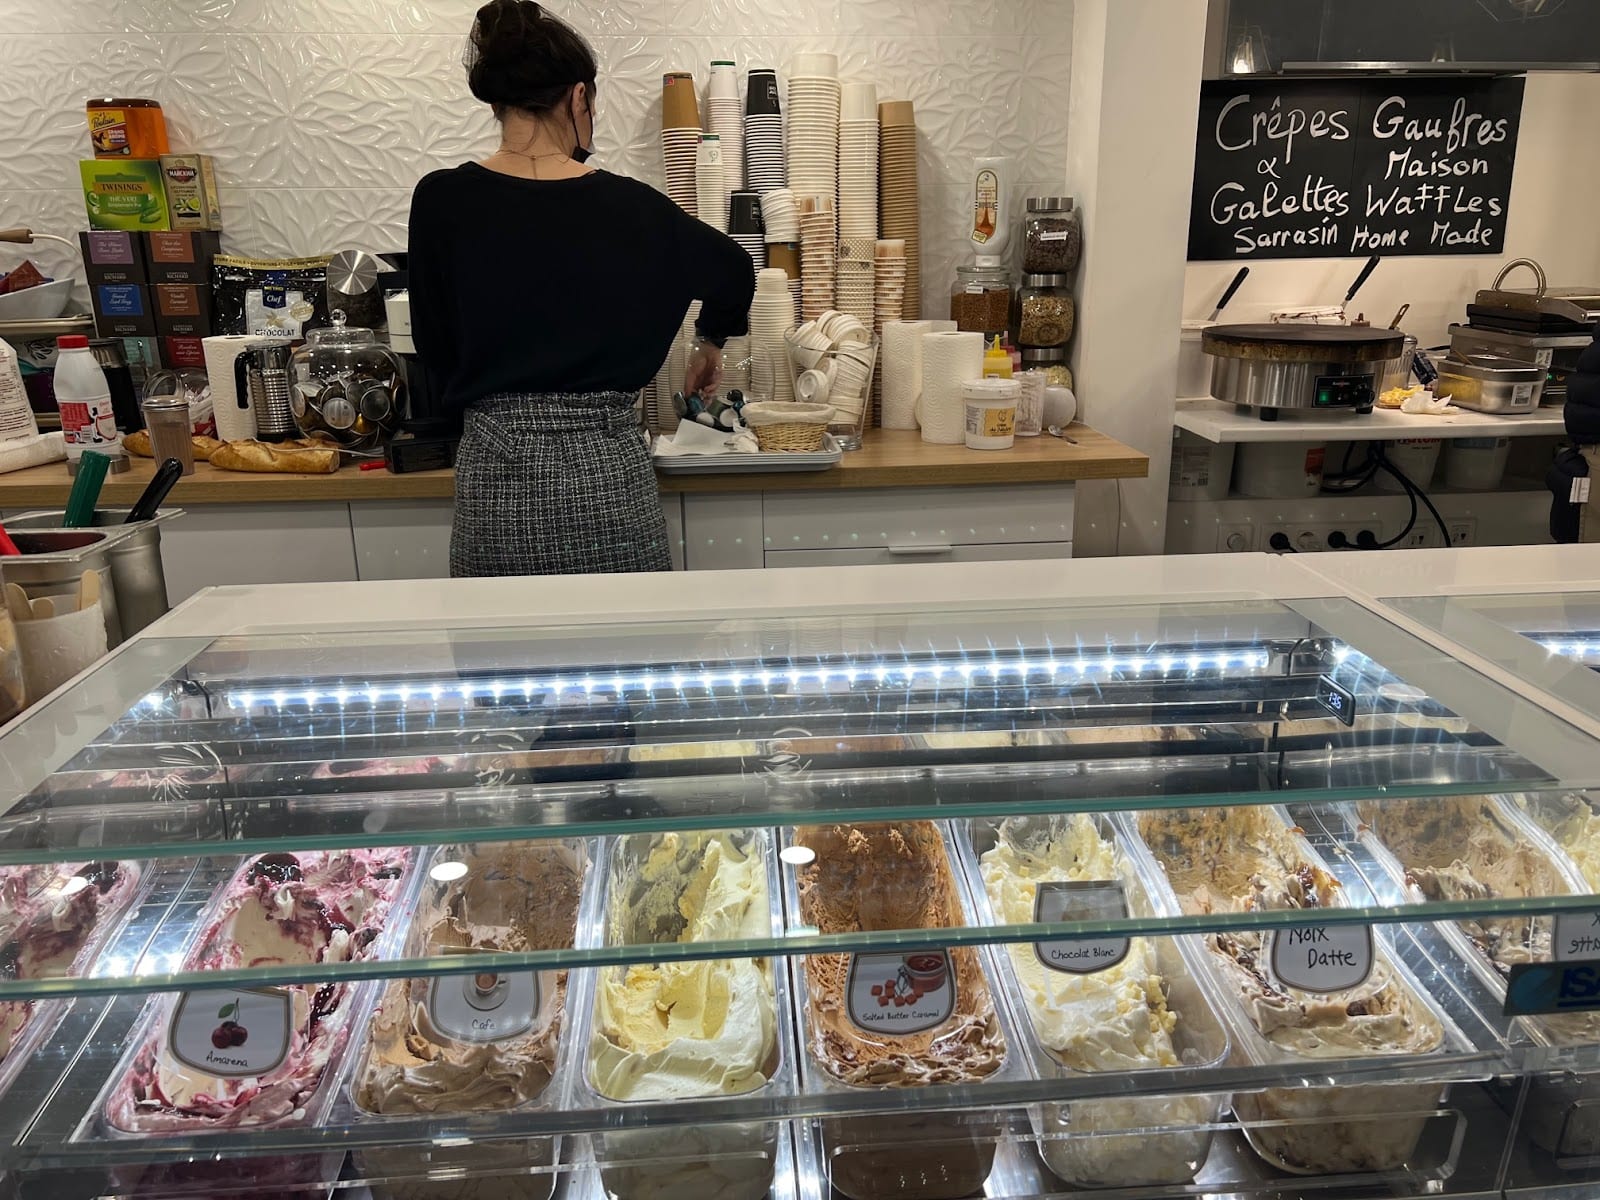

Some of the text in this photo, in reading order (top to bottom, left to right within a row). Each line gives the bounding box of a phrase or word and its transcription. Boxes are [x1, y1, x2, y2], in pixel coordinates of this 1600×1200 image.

[1216, 94, 1351, 165] Crêpes
[1372, 95, 1508, 154] Gaufres
[1384, 147, 1489, 180] Maison
[101, 183, 143, 192] TWININGS
[1210, 174, 1350, 224] Galettes
[1233, 216, 1338, 254] Sarrasin
[1350, 217, 1493, 253] Home Made
[266, 295, 283, 304] Chef
[255, 329, 296, 337] CHOCOLAT
[1051, 947, 1116, 961] Chocolat Blanc
[1308, 947, 1357, 969] Datte
[862, 1009, 940, 1022] Salted Butter Caramel
[206, 1050, 249, 1068] Amarena
